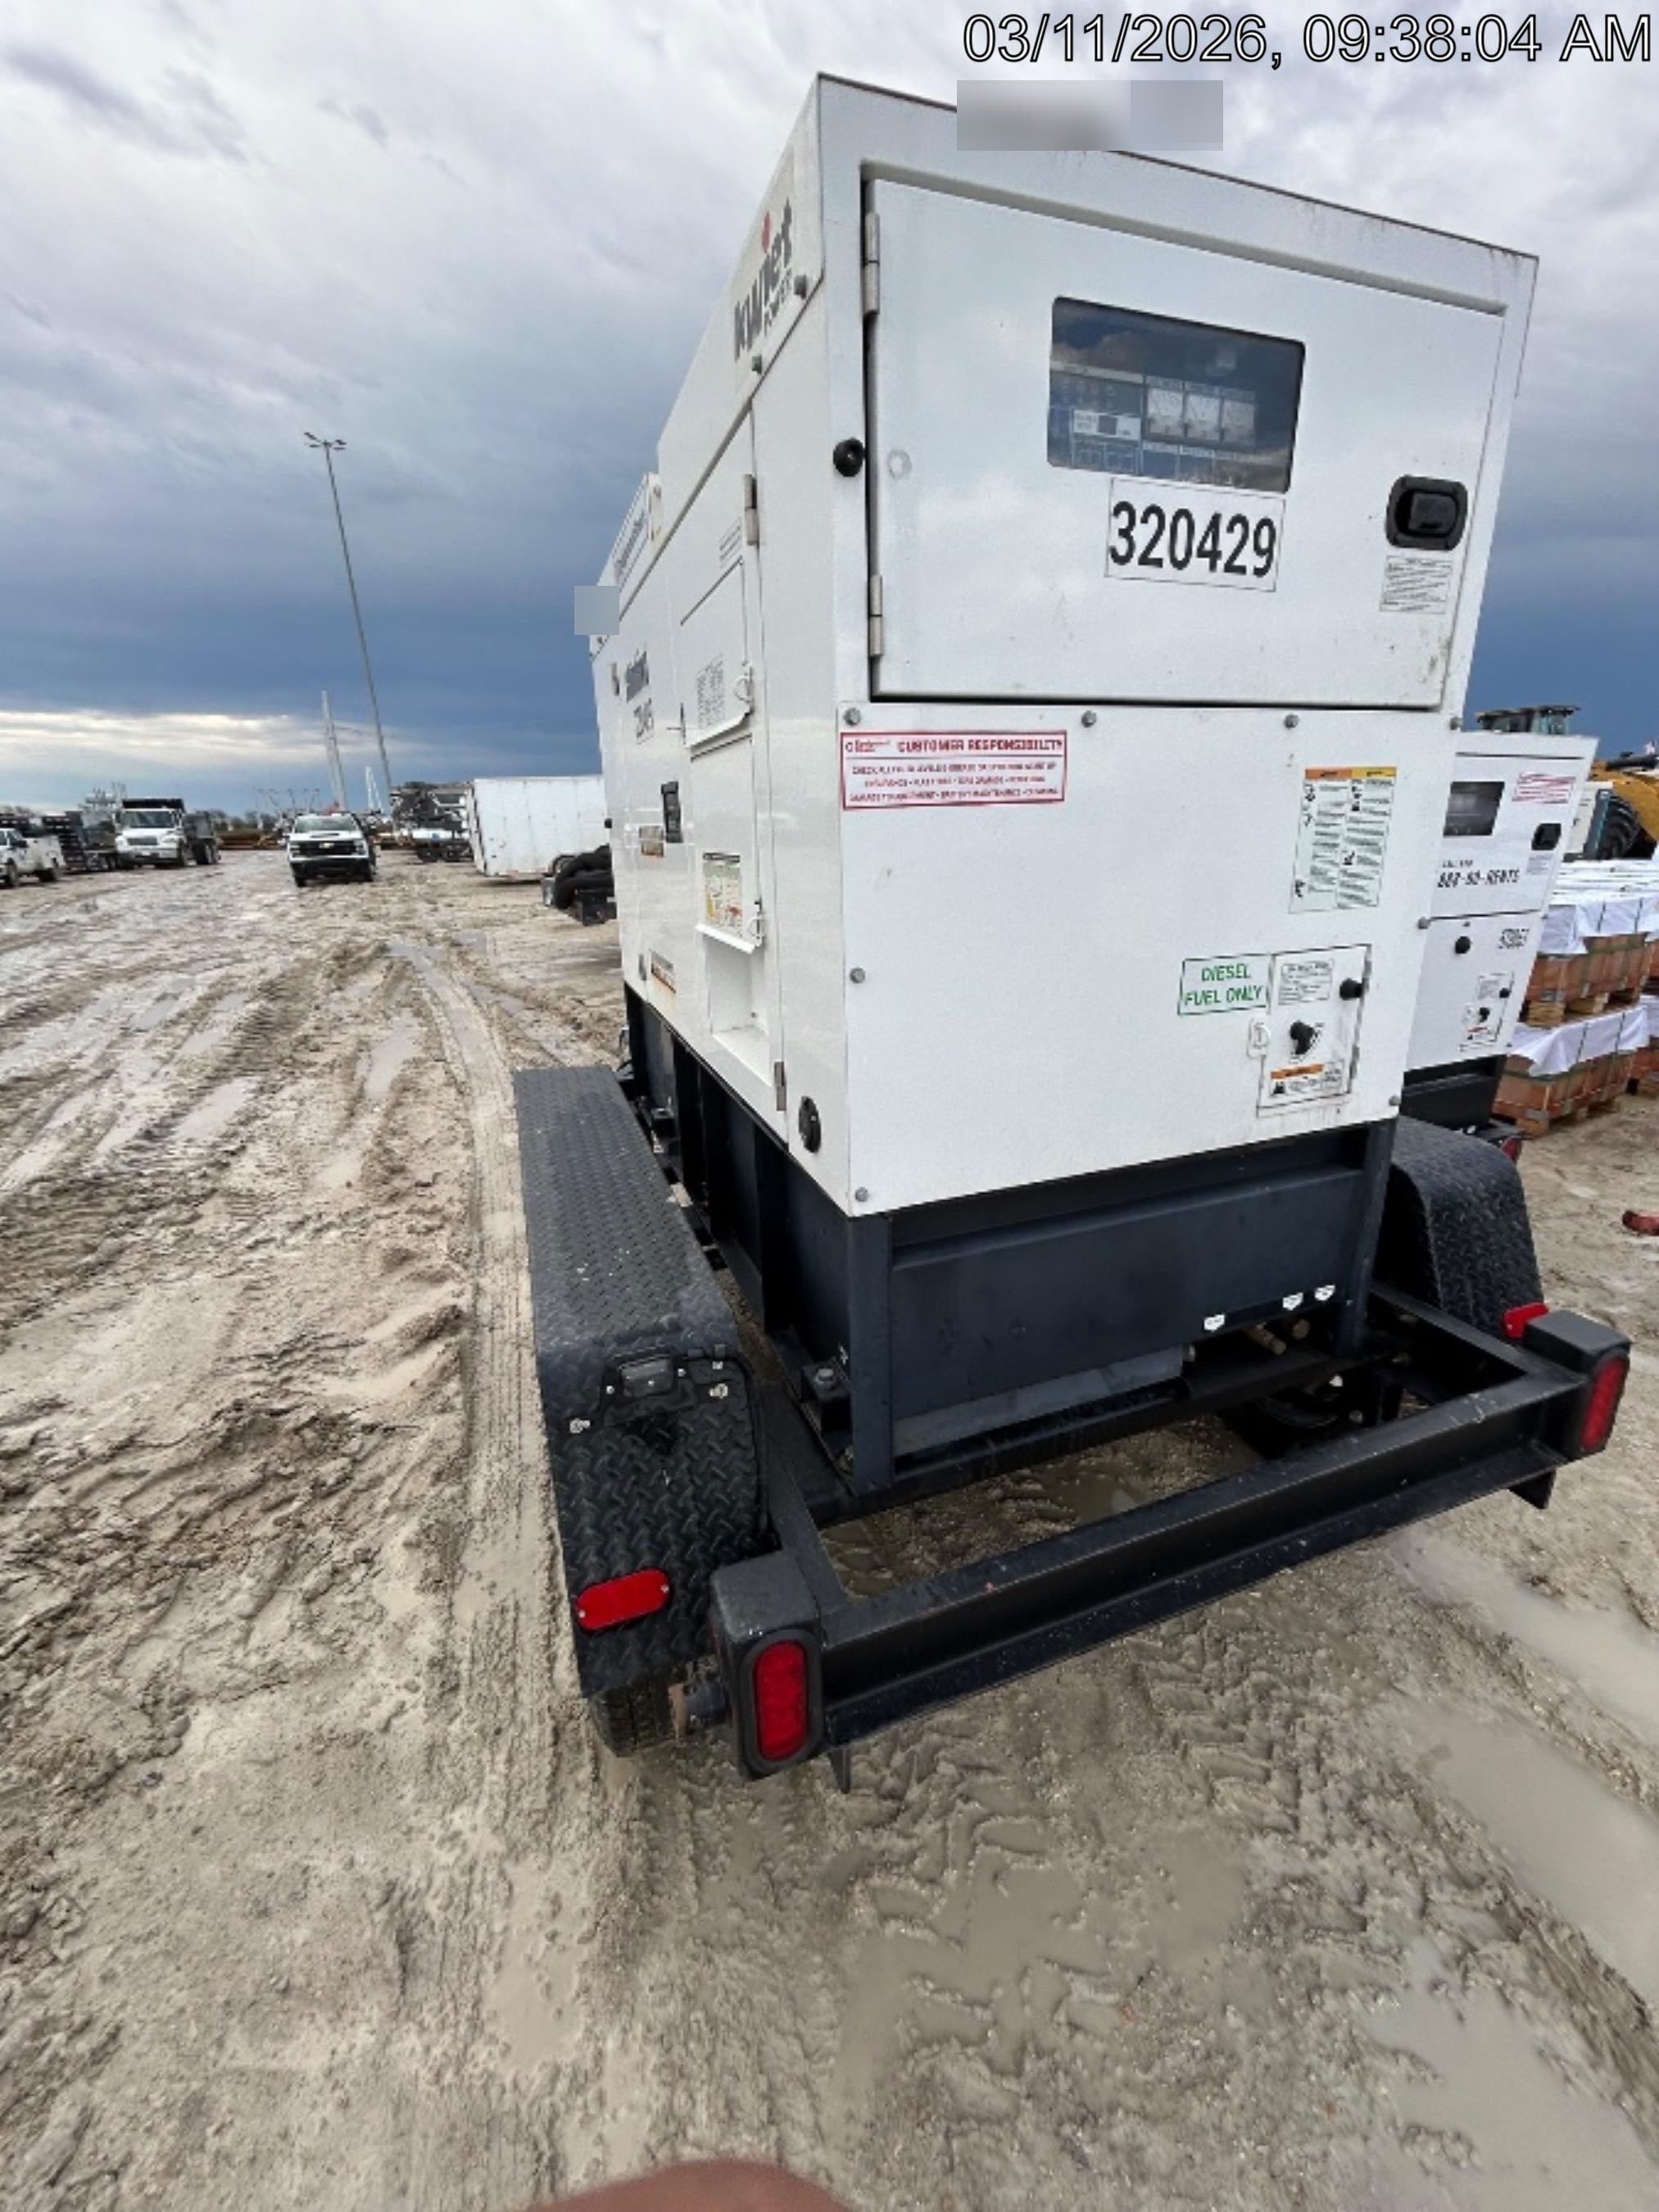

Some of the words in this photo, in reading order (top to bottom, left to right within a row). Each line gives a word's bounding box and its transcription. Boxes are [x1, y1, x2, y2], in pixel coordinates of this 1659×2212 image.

[1109, 500, 1277, 578] 320429
[897, 739, 964, 753] CUSTOMER
[968, 738, 1063, 750] RESPONSIBILITY
[1201, 963, 1252, 981] DIESEL
[1184, 989, 1222, 1006] FUEL
[1226, 985, 1263, 1003] ONLY
